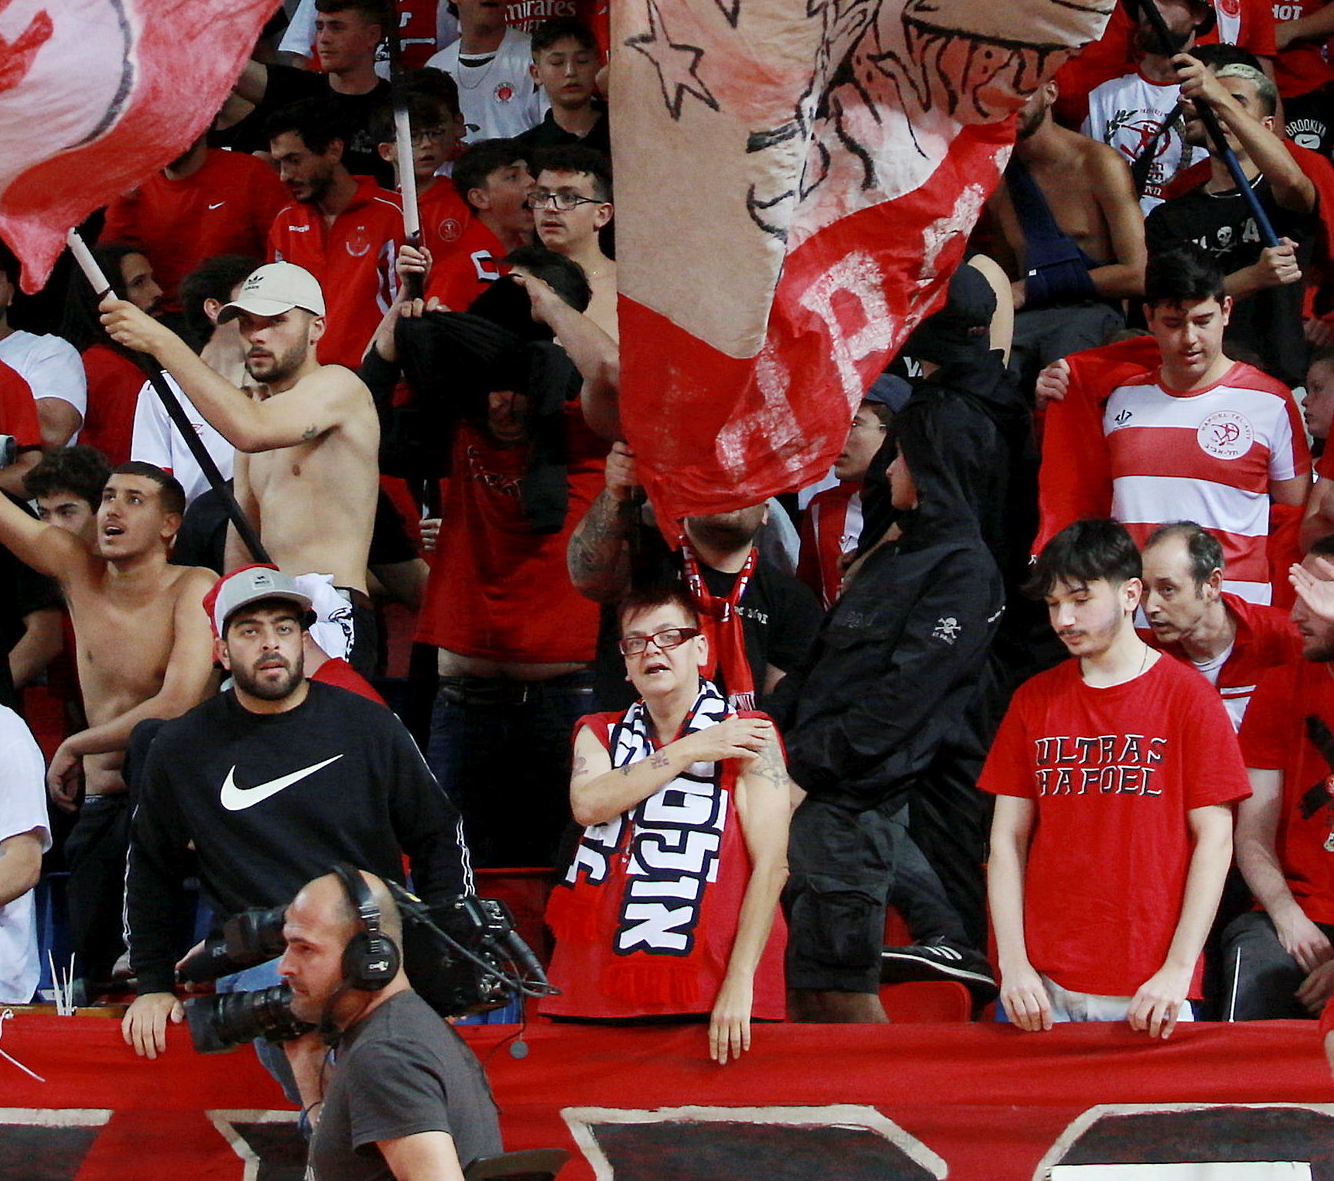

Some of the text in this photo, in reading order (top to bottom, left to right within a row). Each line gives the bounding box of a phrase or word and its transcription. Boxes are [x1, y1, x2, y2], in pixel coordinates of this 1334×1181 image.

[1270, 4, 1306, 23] HOT
[1033, 735, 1169, 766] ULTRAS
[1034, 766, 1165, 798] HAPOEL
